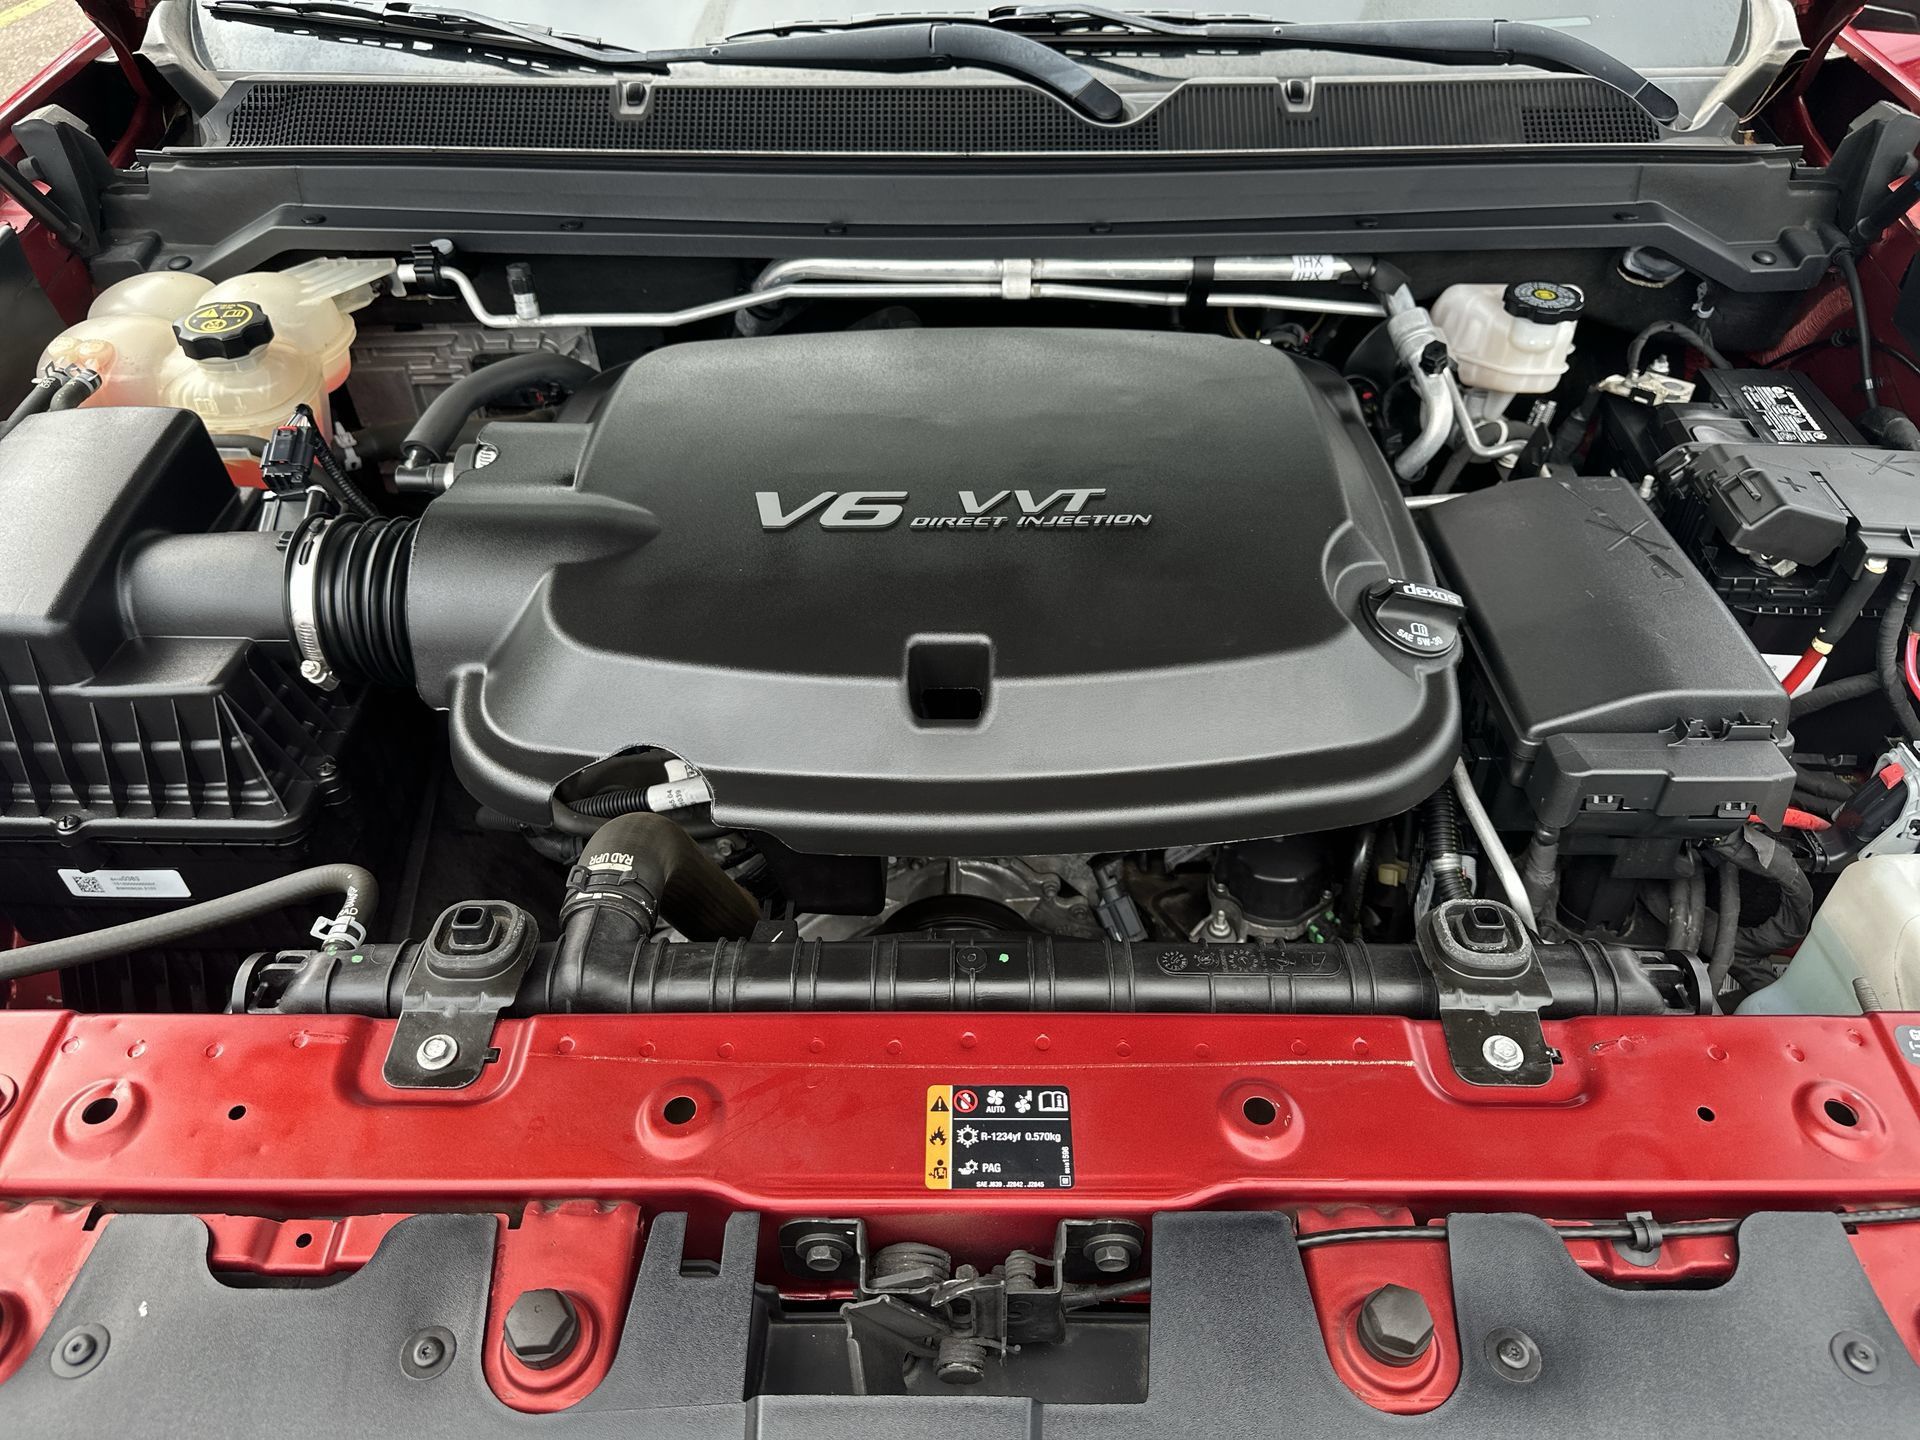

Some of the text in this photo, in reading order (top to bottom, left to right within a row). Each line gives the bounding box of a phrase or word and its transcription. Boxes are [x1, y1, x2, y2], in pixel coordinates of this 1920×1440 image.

[755, 488, 1106, 529] V6 VVT
[910, 514, 1152, 528] DIRECT INJECTION
[1403, 583, 1459, 605] dexos
[1397, 629, 1443, 646] SAE 5W-30
[589, 852, 634, 866] RAD UPR
[981, 1132, 1061, 1142] R-1234yf 0.570kg
[982, 1163, 1001, 1173] PAG
